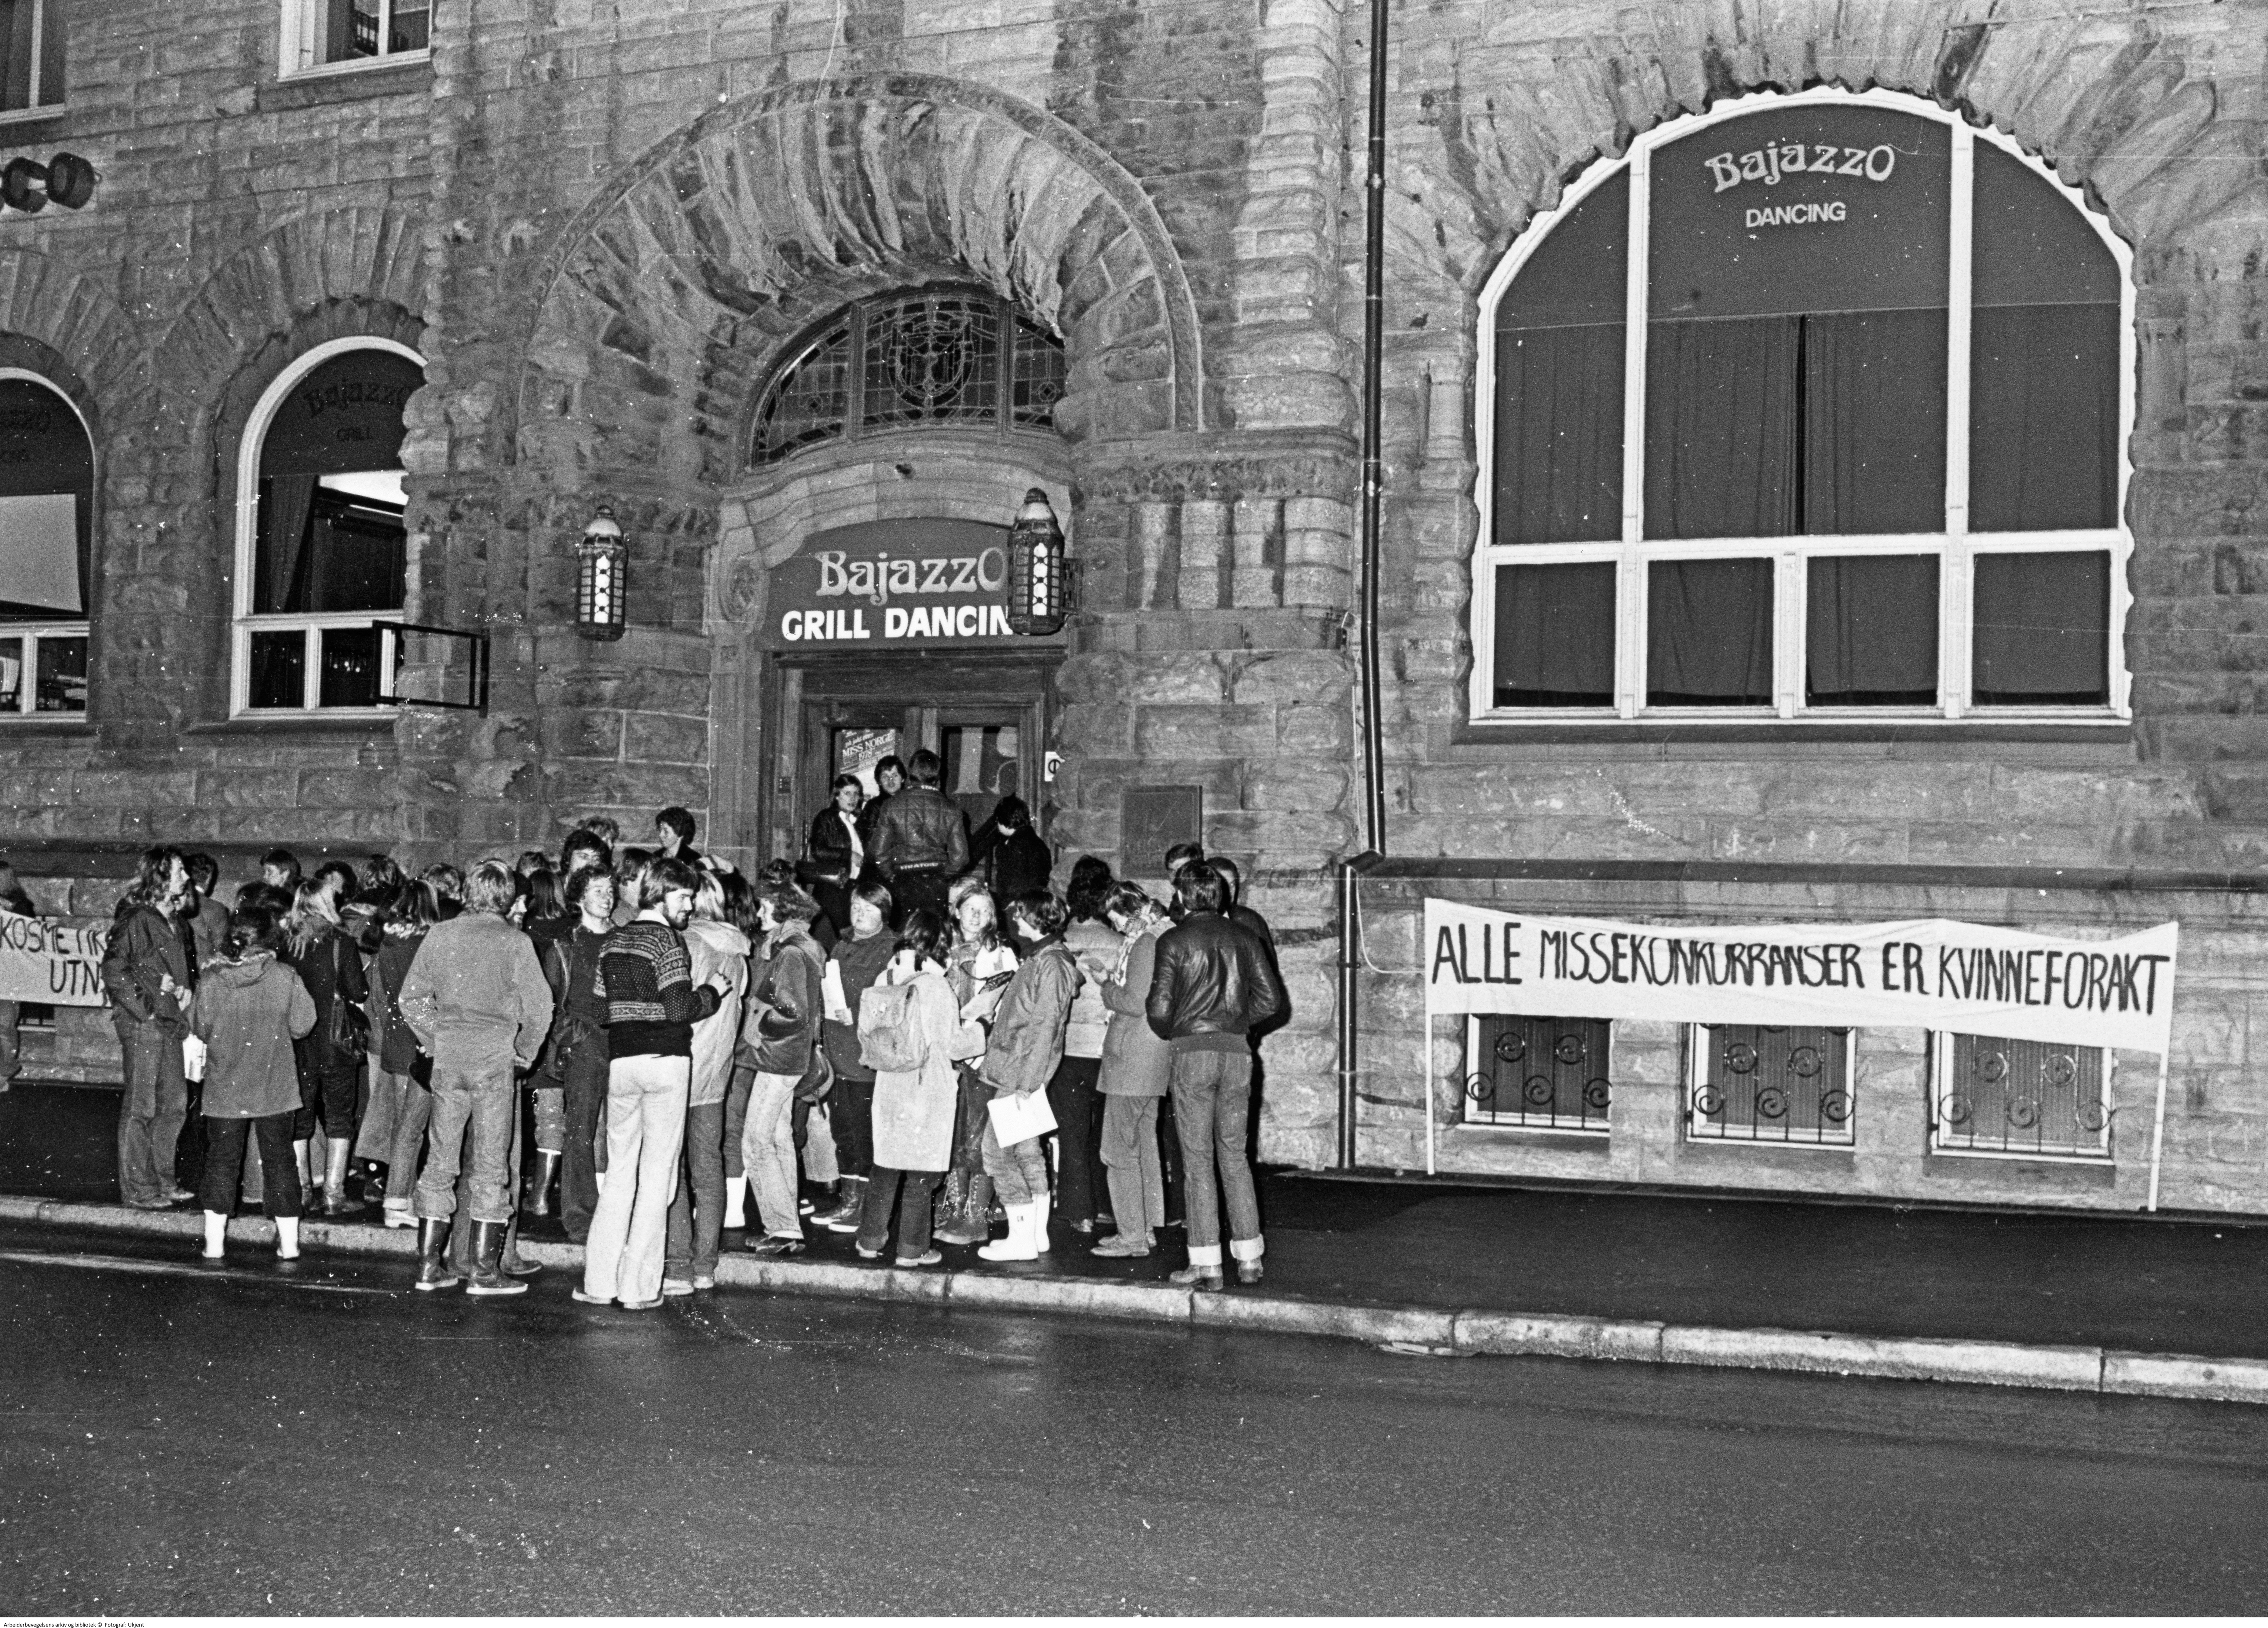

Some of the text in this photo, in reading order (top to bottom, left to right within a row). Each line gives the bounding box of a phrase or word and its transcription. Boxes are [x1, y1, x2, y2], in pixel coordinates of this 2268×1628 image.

[1745, 201, 1846, 228] DANCING
[782, 605, 1013, 641] GRILL DANCIN
[842, 743, 864, 758] MISS
[50, 958, 100, 996] UTN
[1432, 922, 2170, 1015] ALLE MISSEKONKURRANSER ER KVINNEFORAKT
